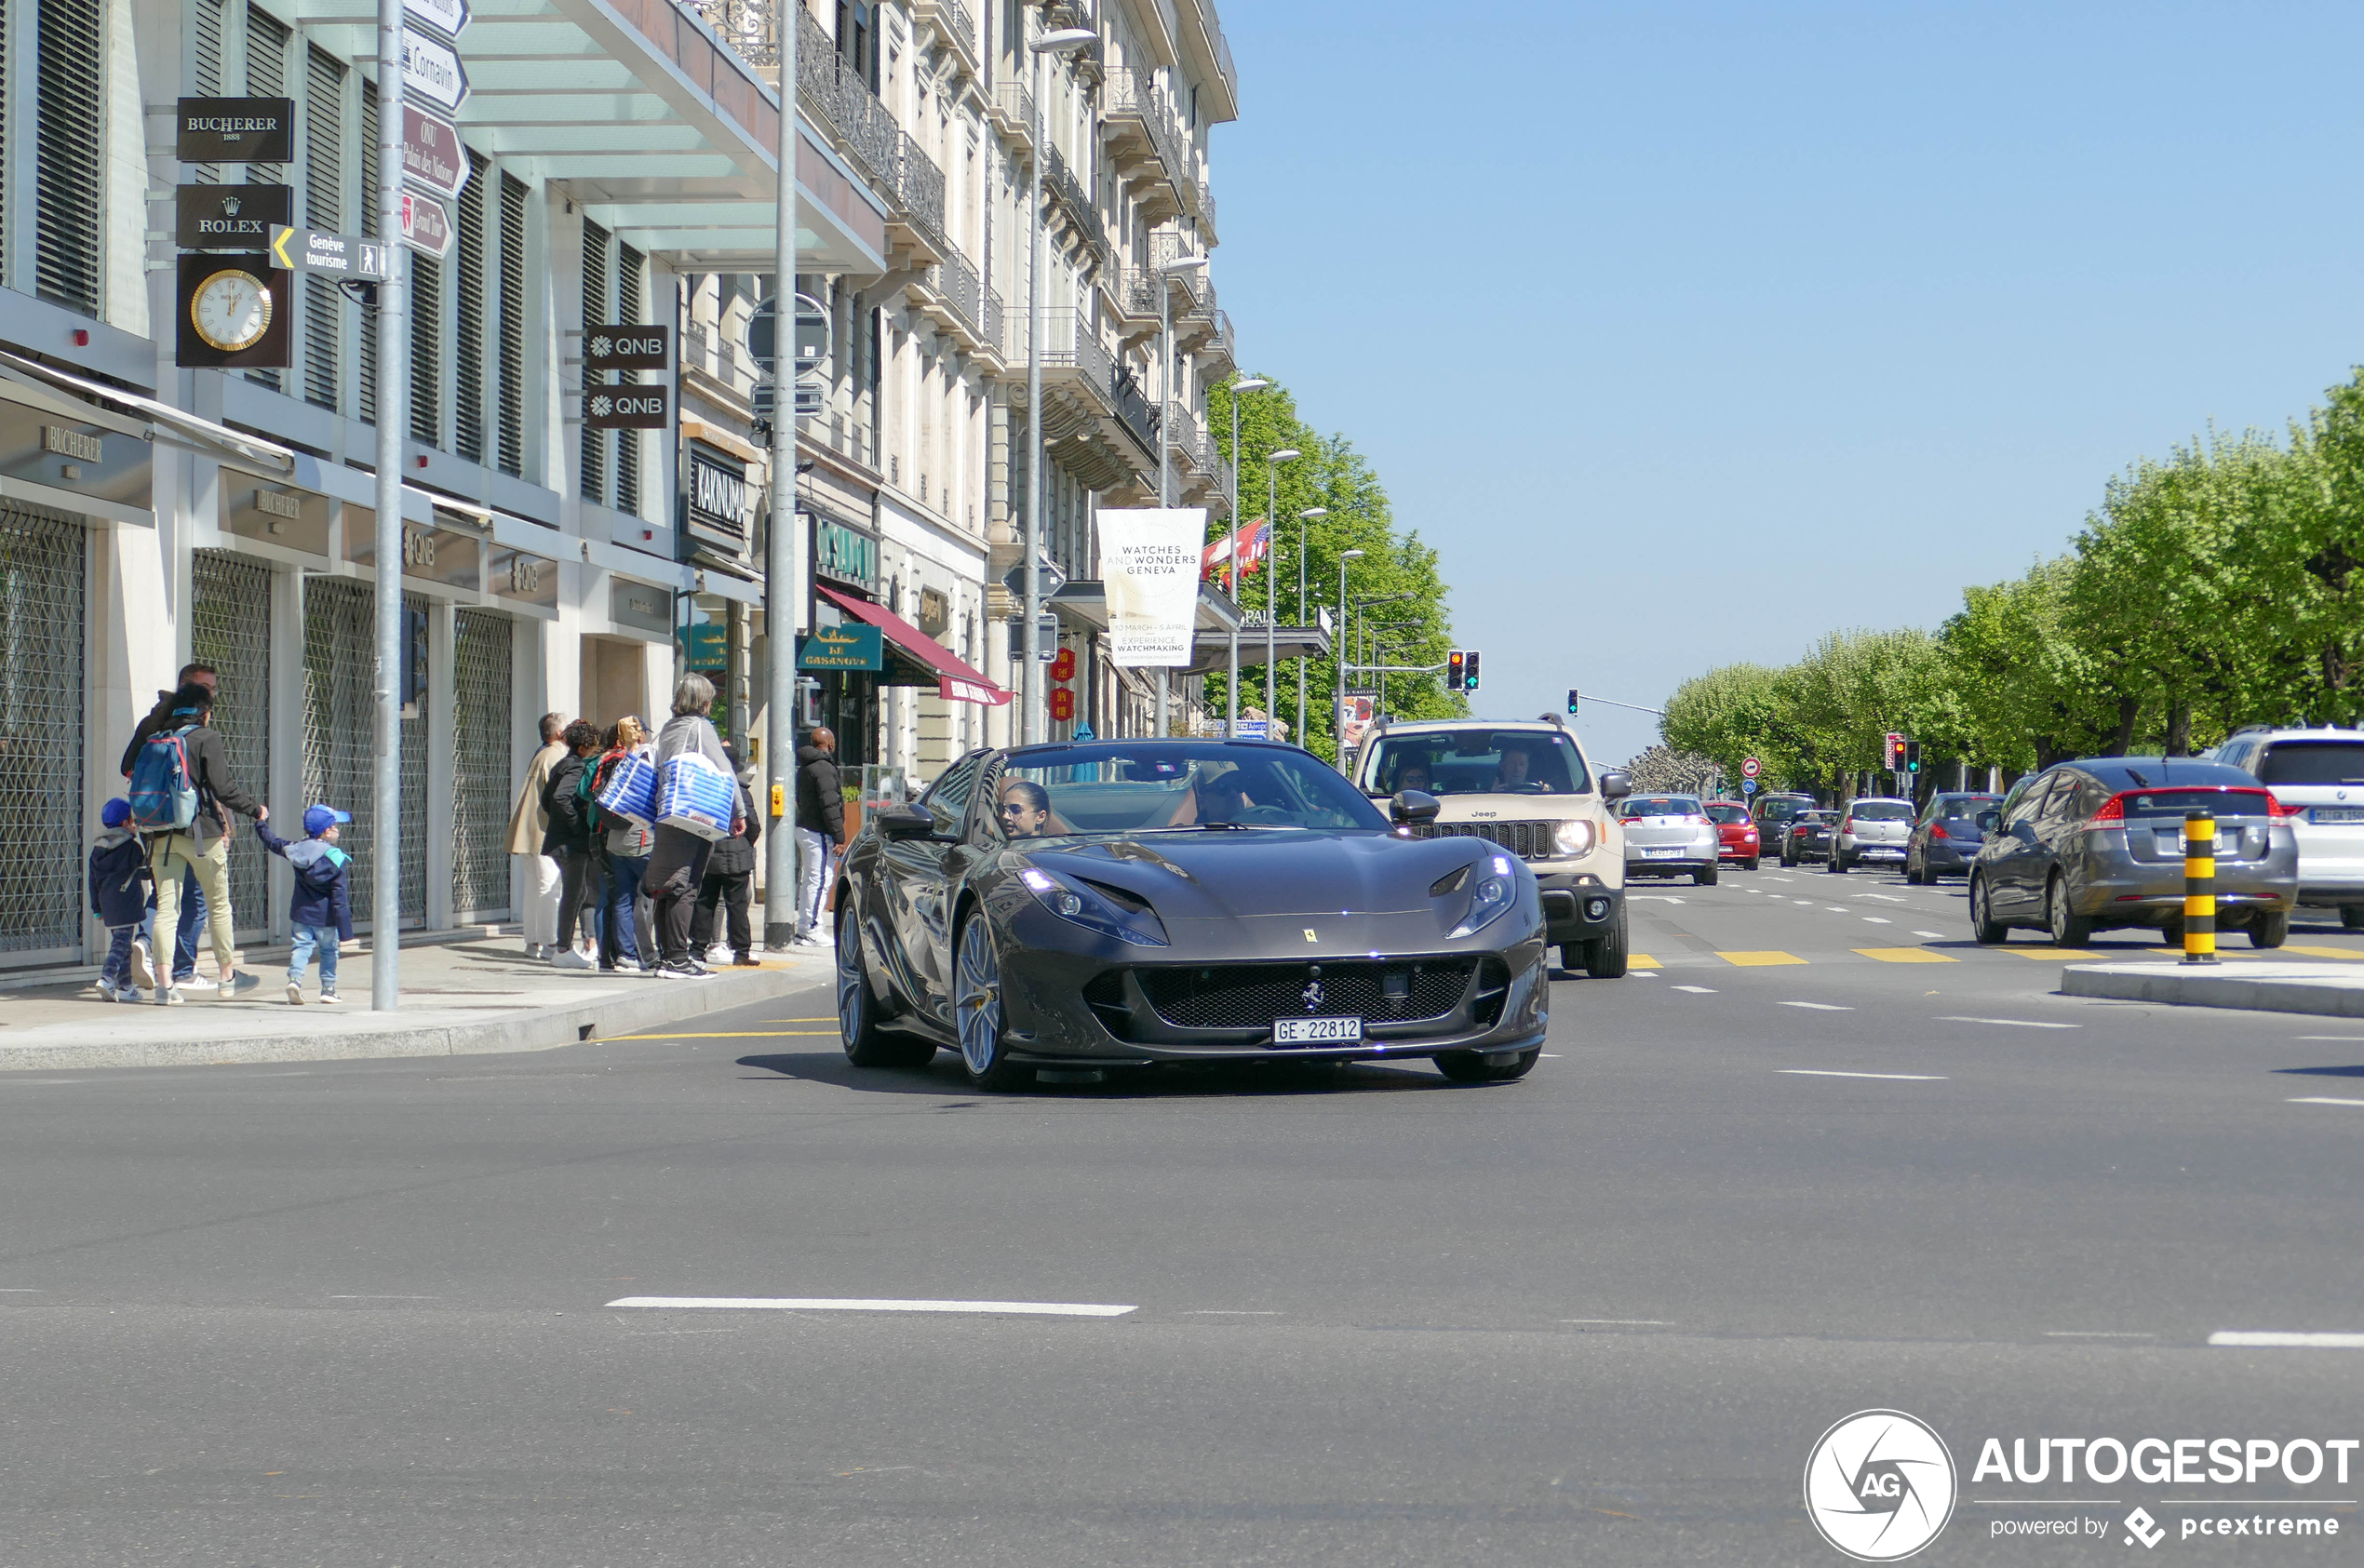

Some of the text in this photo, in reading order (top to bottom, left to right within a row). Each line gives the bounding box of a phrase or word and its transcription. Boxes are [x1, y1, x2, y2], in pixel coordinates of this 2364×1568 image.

[413, 47, 453, 91] Cornavin
[187, 117, 277, 132] BUCHERER
[421, 121, 437, 147] ONU
[402, 141, 453, 185] Palais des Nations
[199, 220, 263, 233] ROLEX
[414, 207, 443, 238] Grand Tour
[309, 234, 345, 252] Genève
[305, 251, 348, 270] tourisme
[615, 338, 663, 355] QNB
[615, 397, 663, 415] QNB
[50, 426, 102, 463] BUCHERER
[698, 462, 745, 526] KAKINUMA
[262, 489, 301, 519] BUCHERER
[414, 533, 435, 566] QNB
[1122, 545, 1181, 555] WATCHES
[1107, 556, 1196, 565] AND WONDERS
[1126, 566, 1175, 574] GENEVA
[522, 563, 538, 592] QNB
[658, 764, 672, 814] MIGROS
[691, 814, 712, 825] MIGROS
[1279, 1020, 1357, 1039] GE 22812
